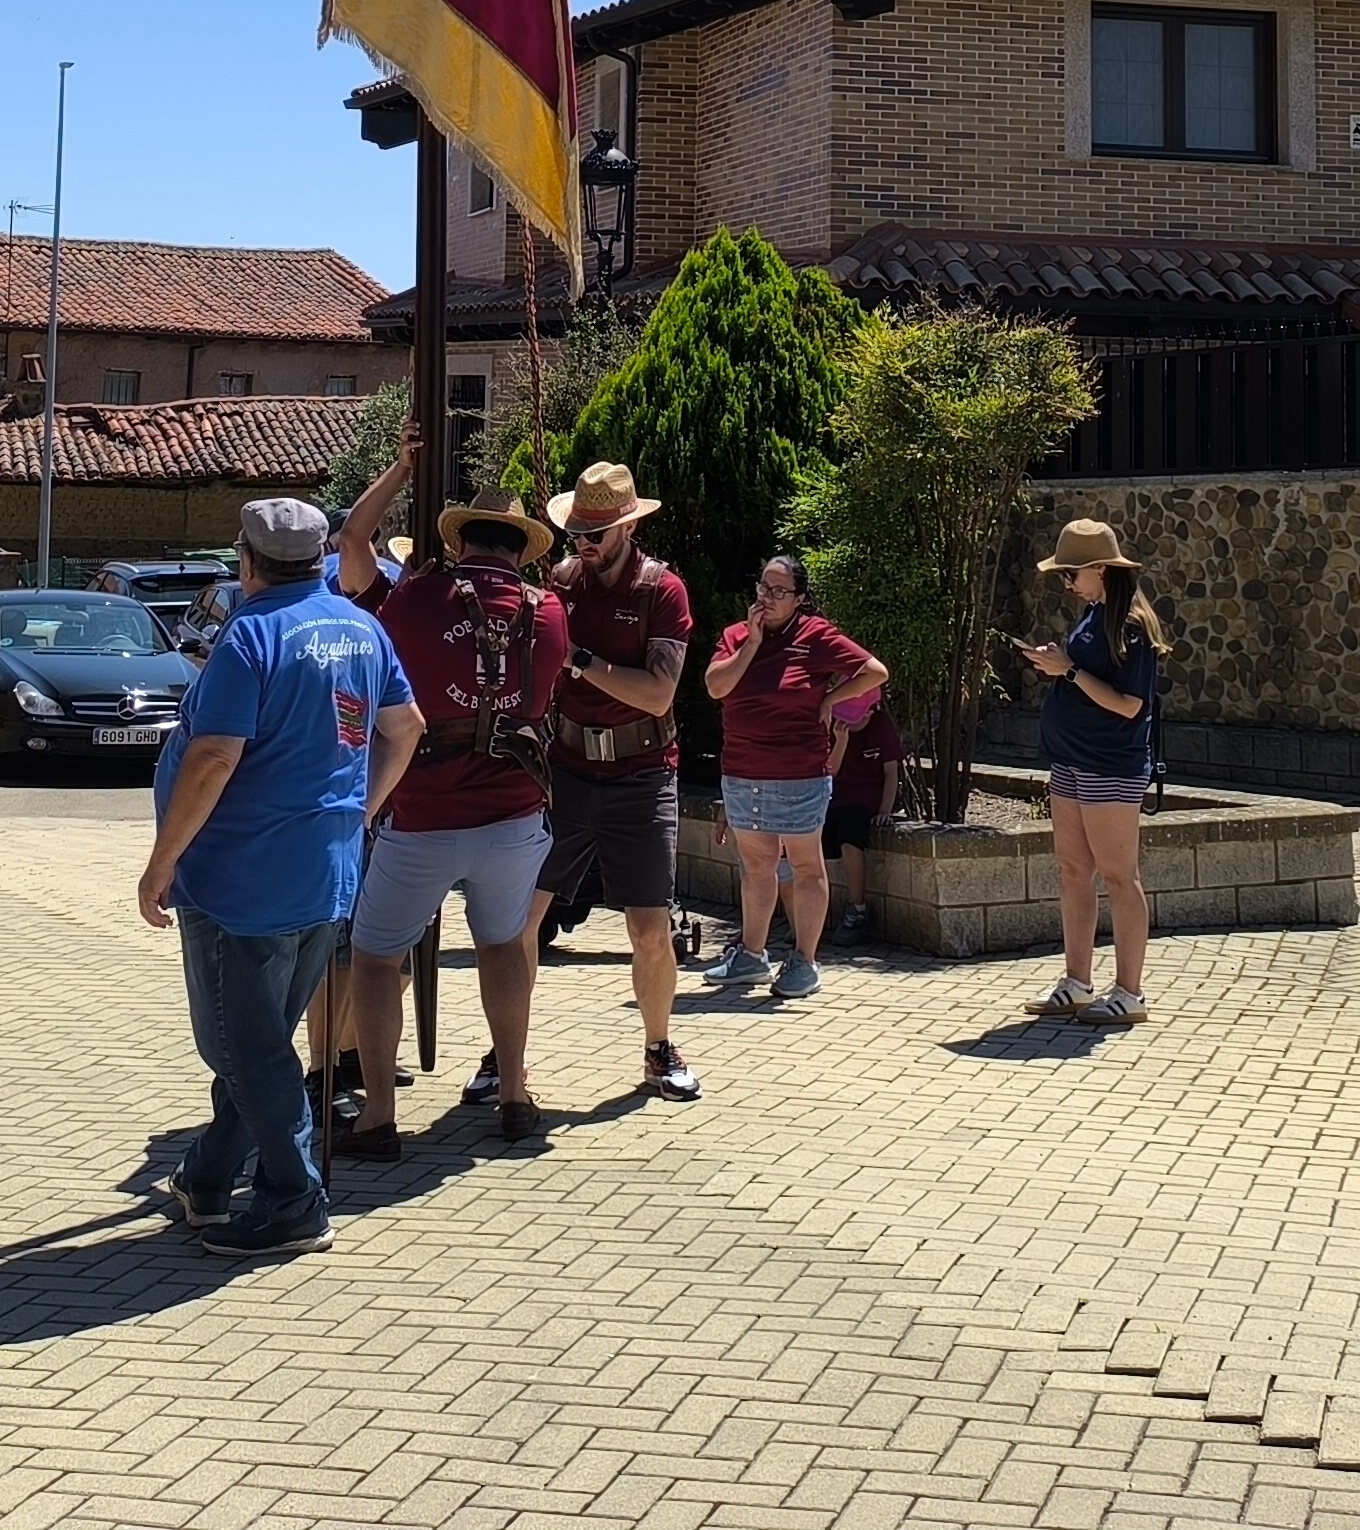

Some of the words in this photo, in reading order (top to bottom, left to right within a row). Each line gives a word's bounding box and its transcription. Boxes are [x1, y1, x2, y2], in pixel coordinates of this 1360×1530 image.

[295, 631, 374, 669] Azadinos
[446, 682, 469, 707] DEL
[101, 730, 132, 743] 6091
[135, 730, 158, 743] GHD
